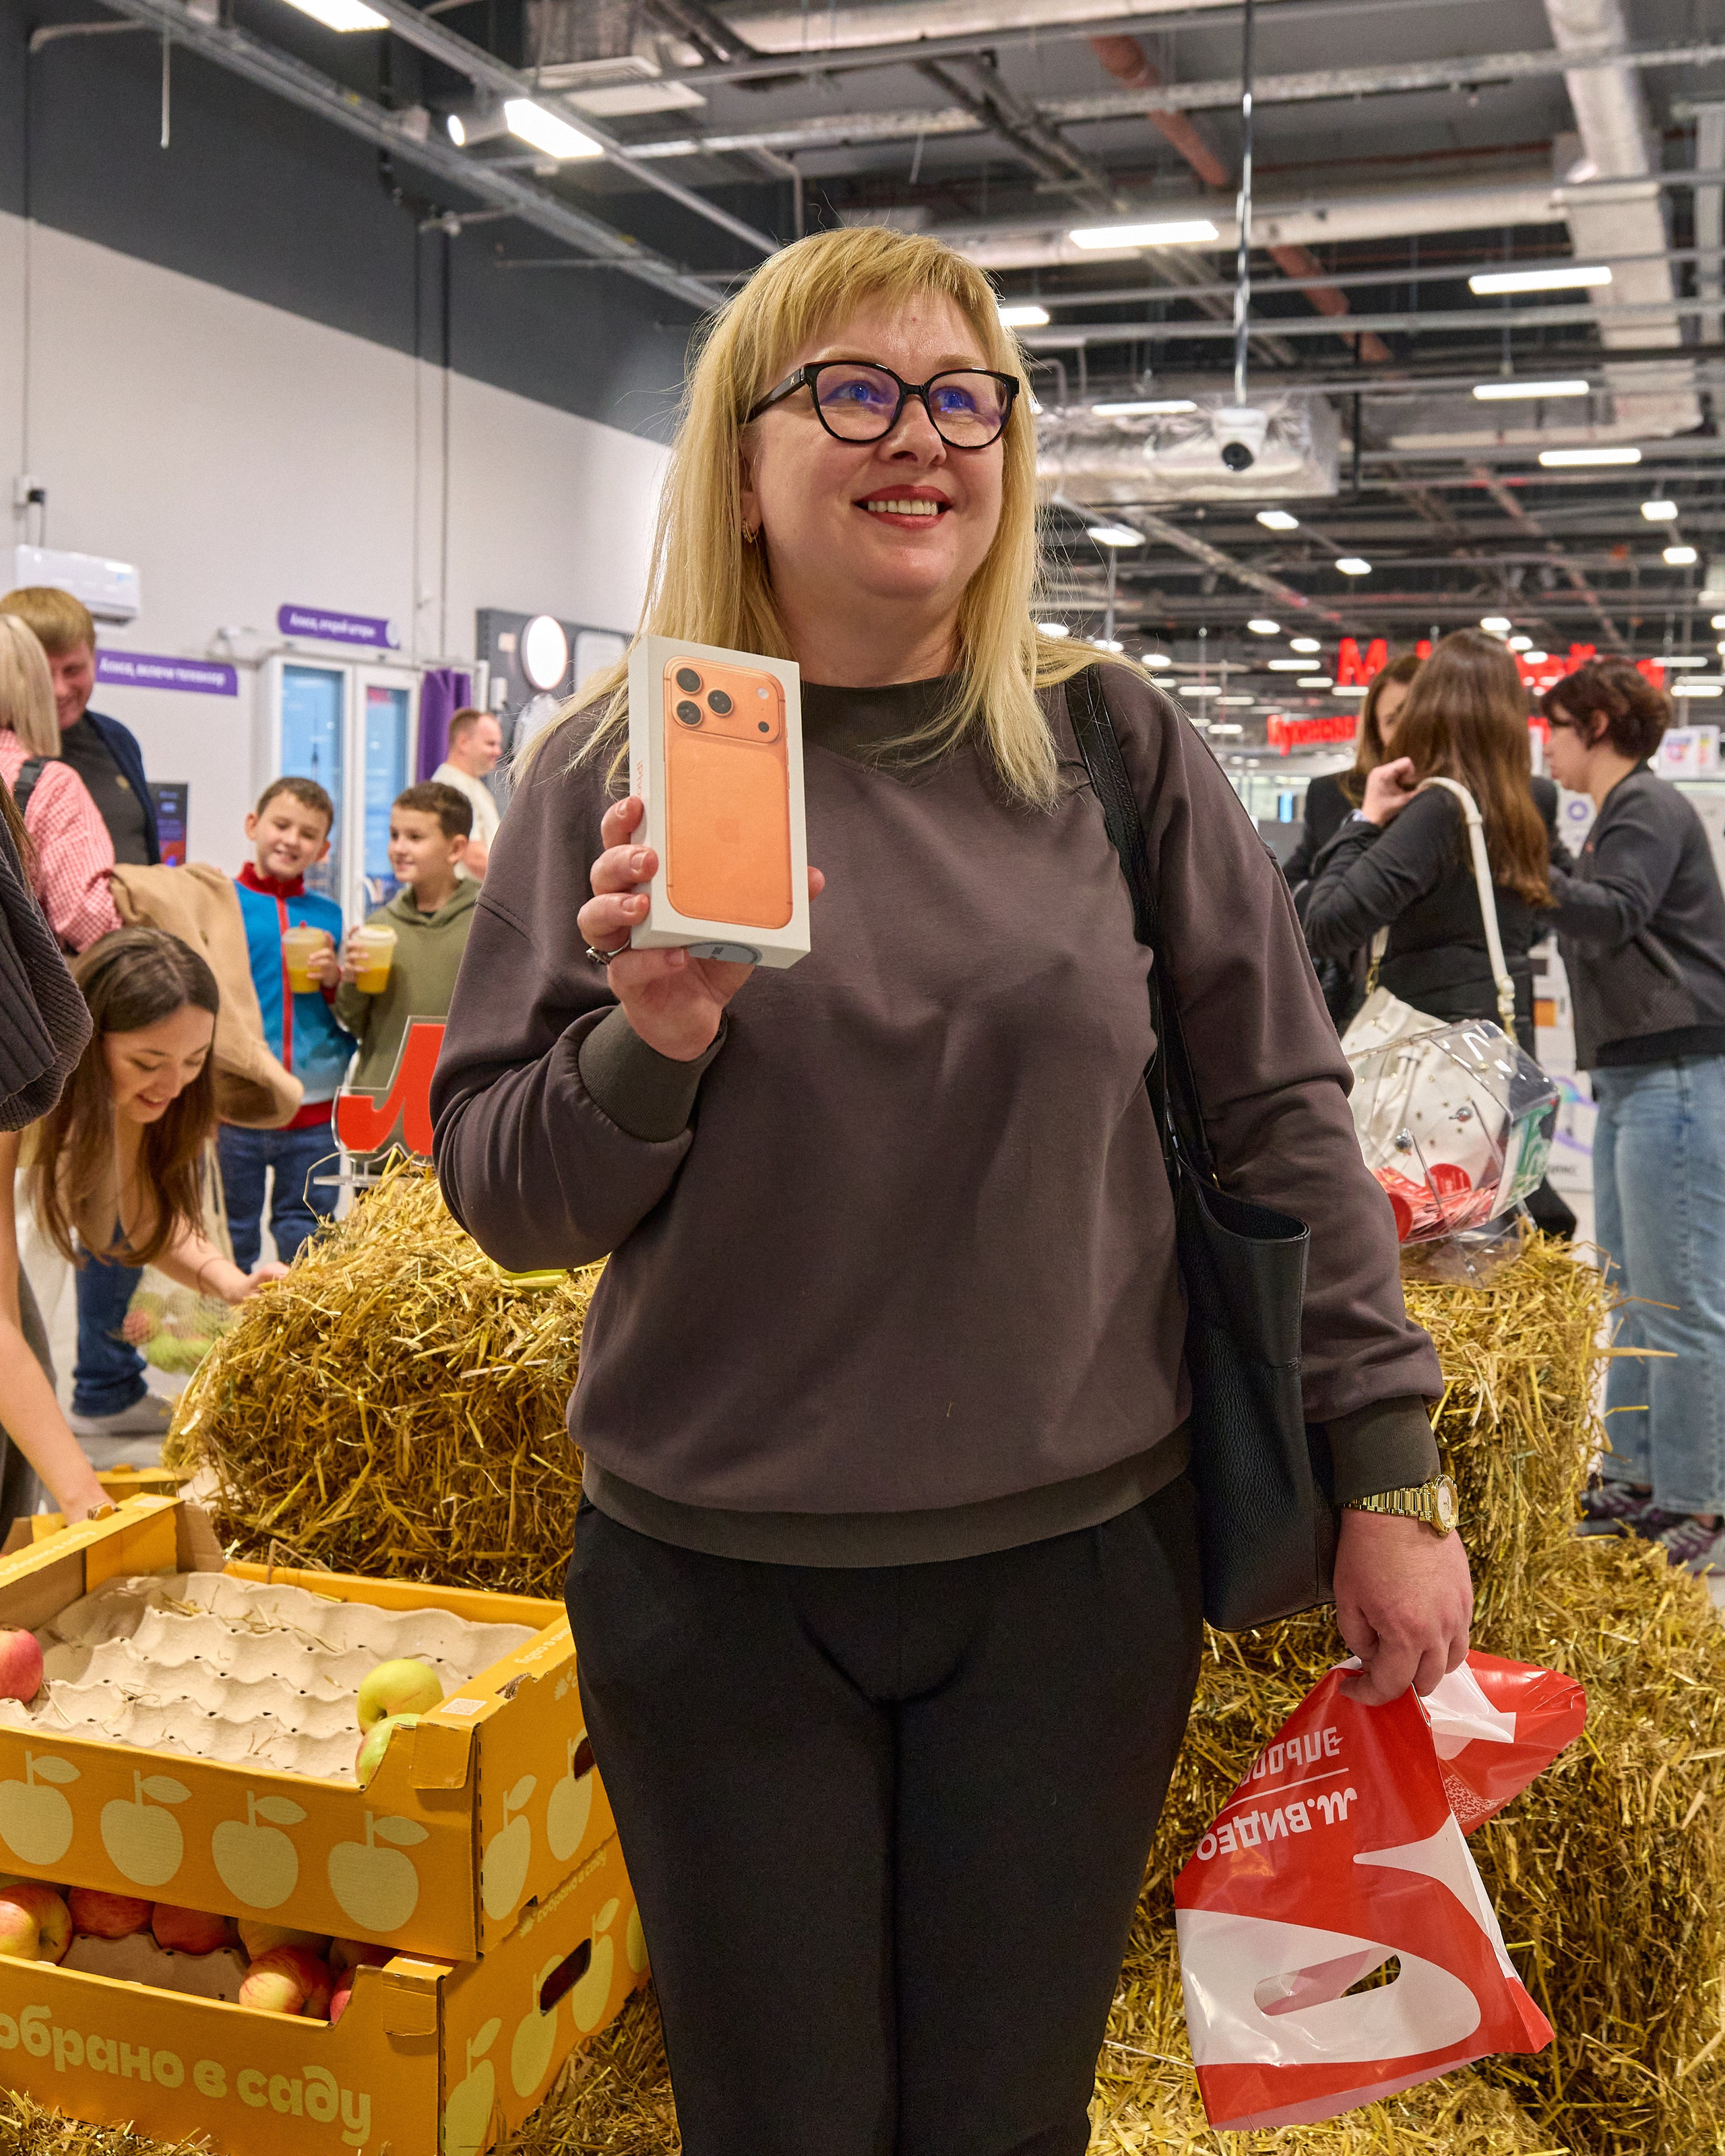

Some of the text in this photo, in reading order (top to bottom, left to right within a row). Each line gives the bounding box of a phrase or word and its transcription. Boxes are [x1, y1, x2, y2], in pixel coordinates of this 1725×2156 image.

[0, 2005, 371, 2147] обрано в саду
